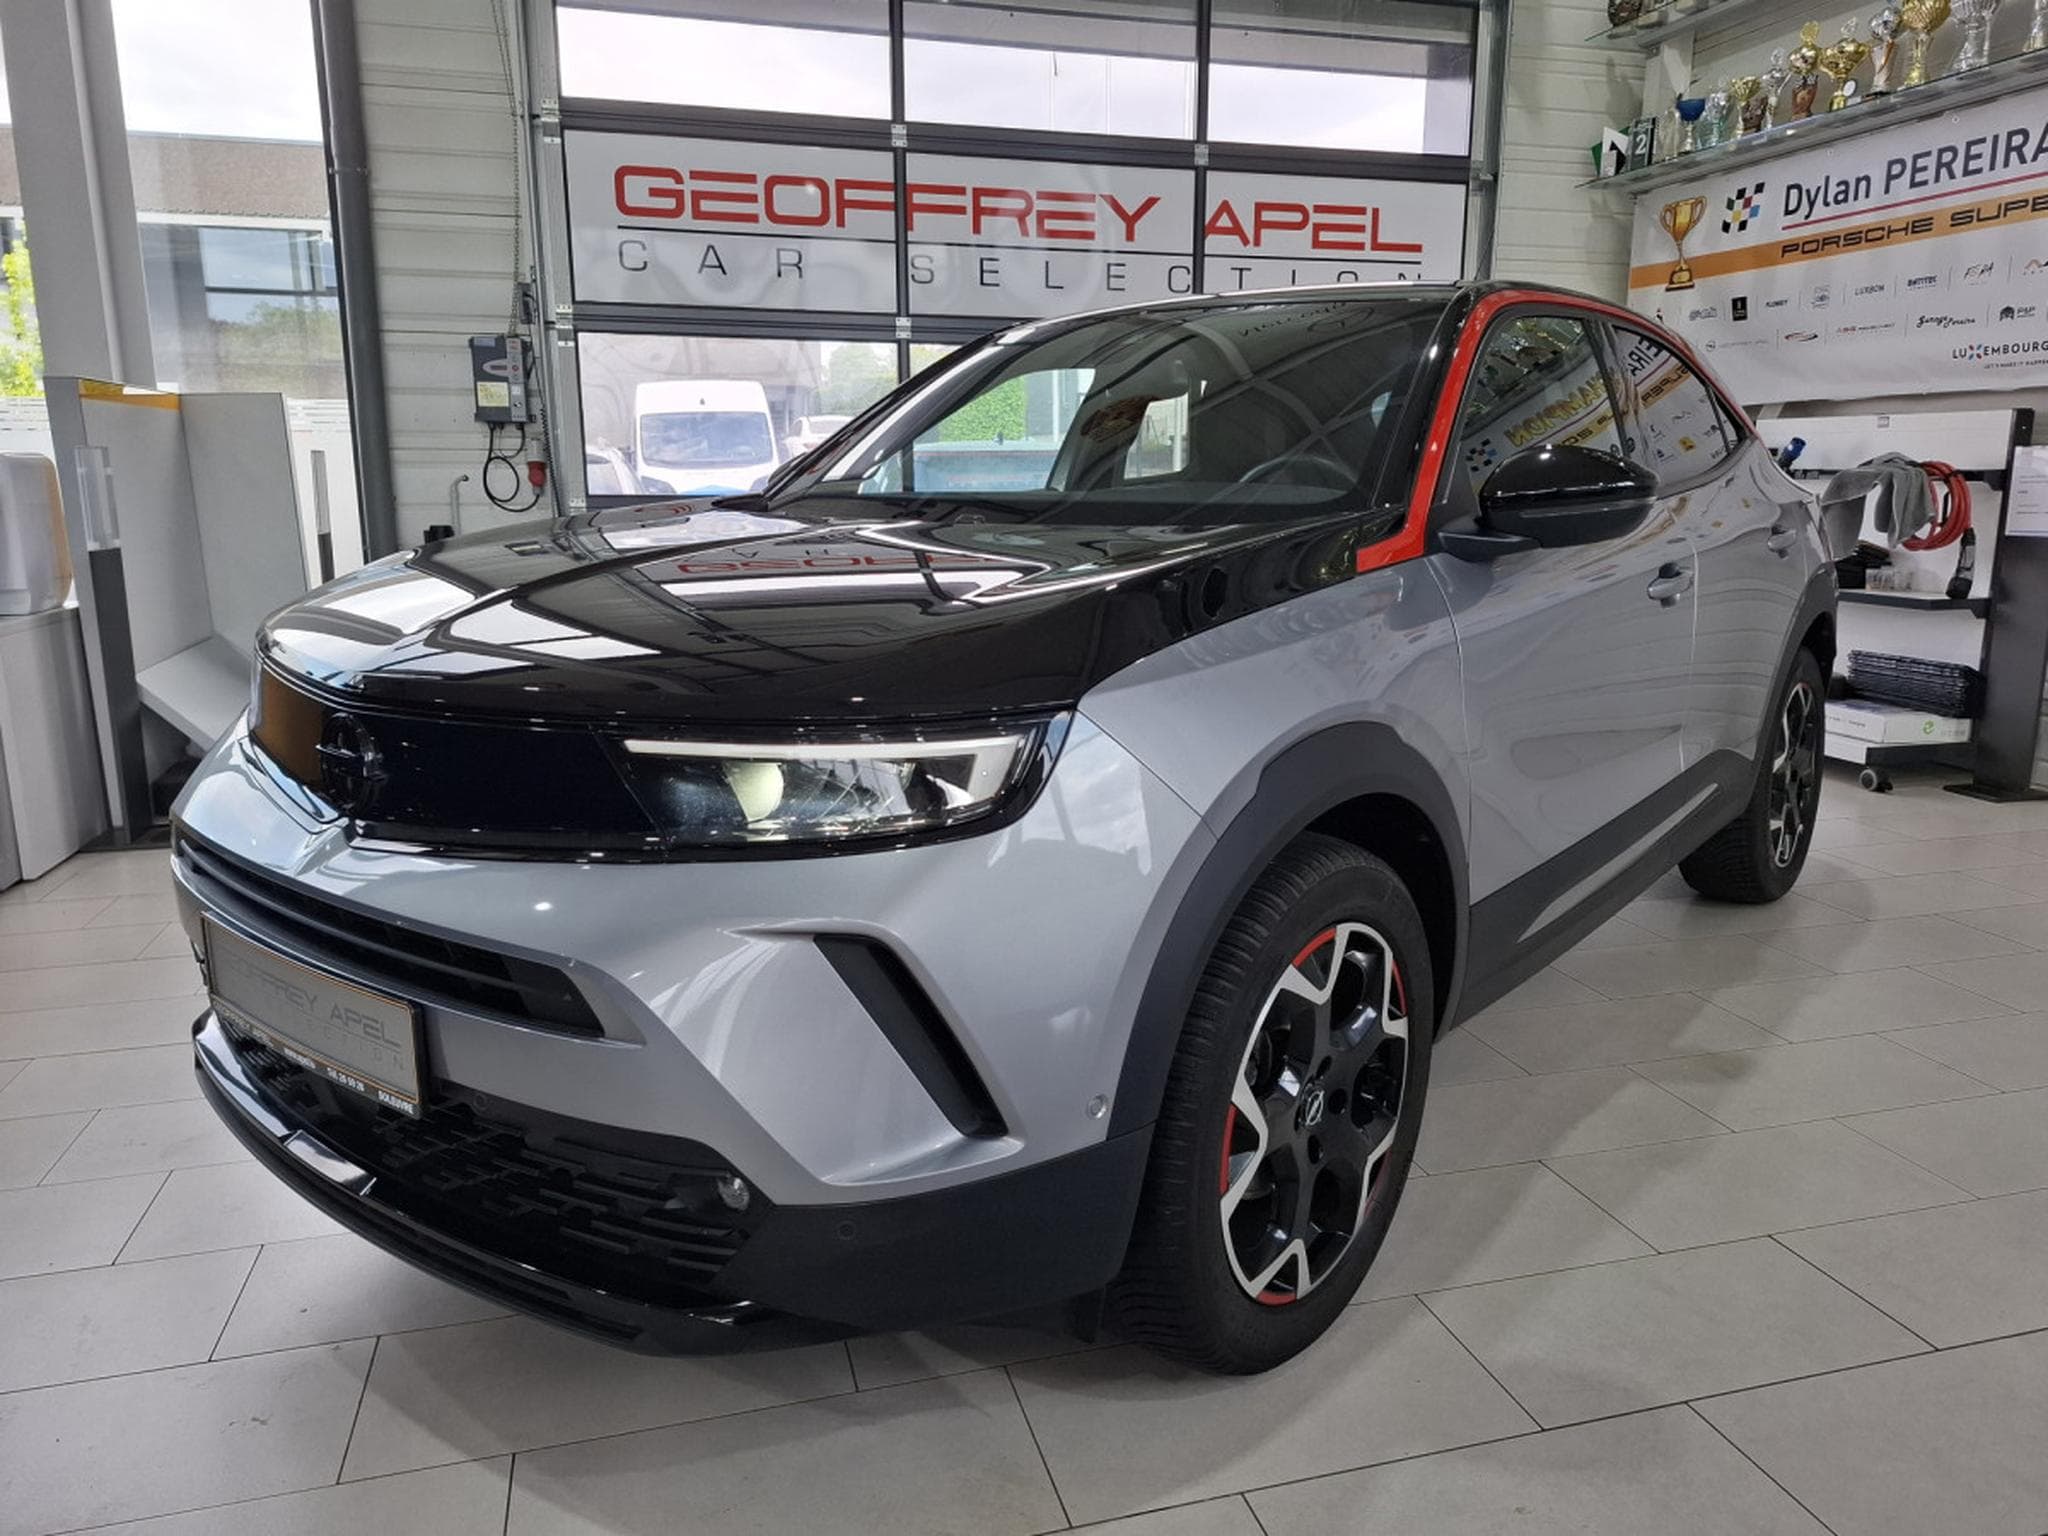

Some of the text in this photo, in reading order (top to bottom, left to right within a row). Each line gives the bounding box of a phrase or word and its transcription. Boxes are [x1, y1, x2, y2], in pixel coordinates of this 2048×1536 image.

[614, 165, 1422, 254] GEOFFREY APEL
[1784, 175, 1871, 221] Dylan
[1781, 216, 1934, 258] PORSCHE
[618, 240, 1421, 294] CAR SELECTI
